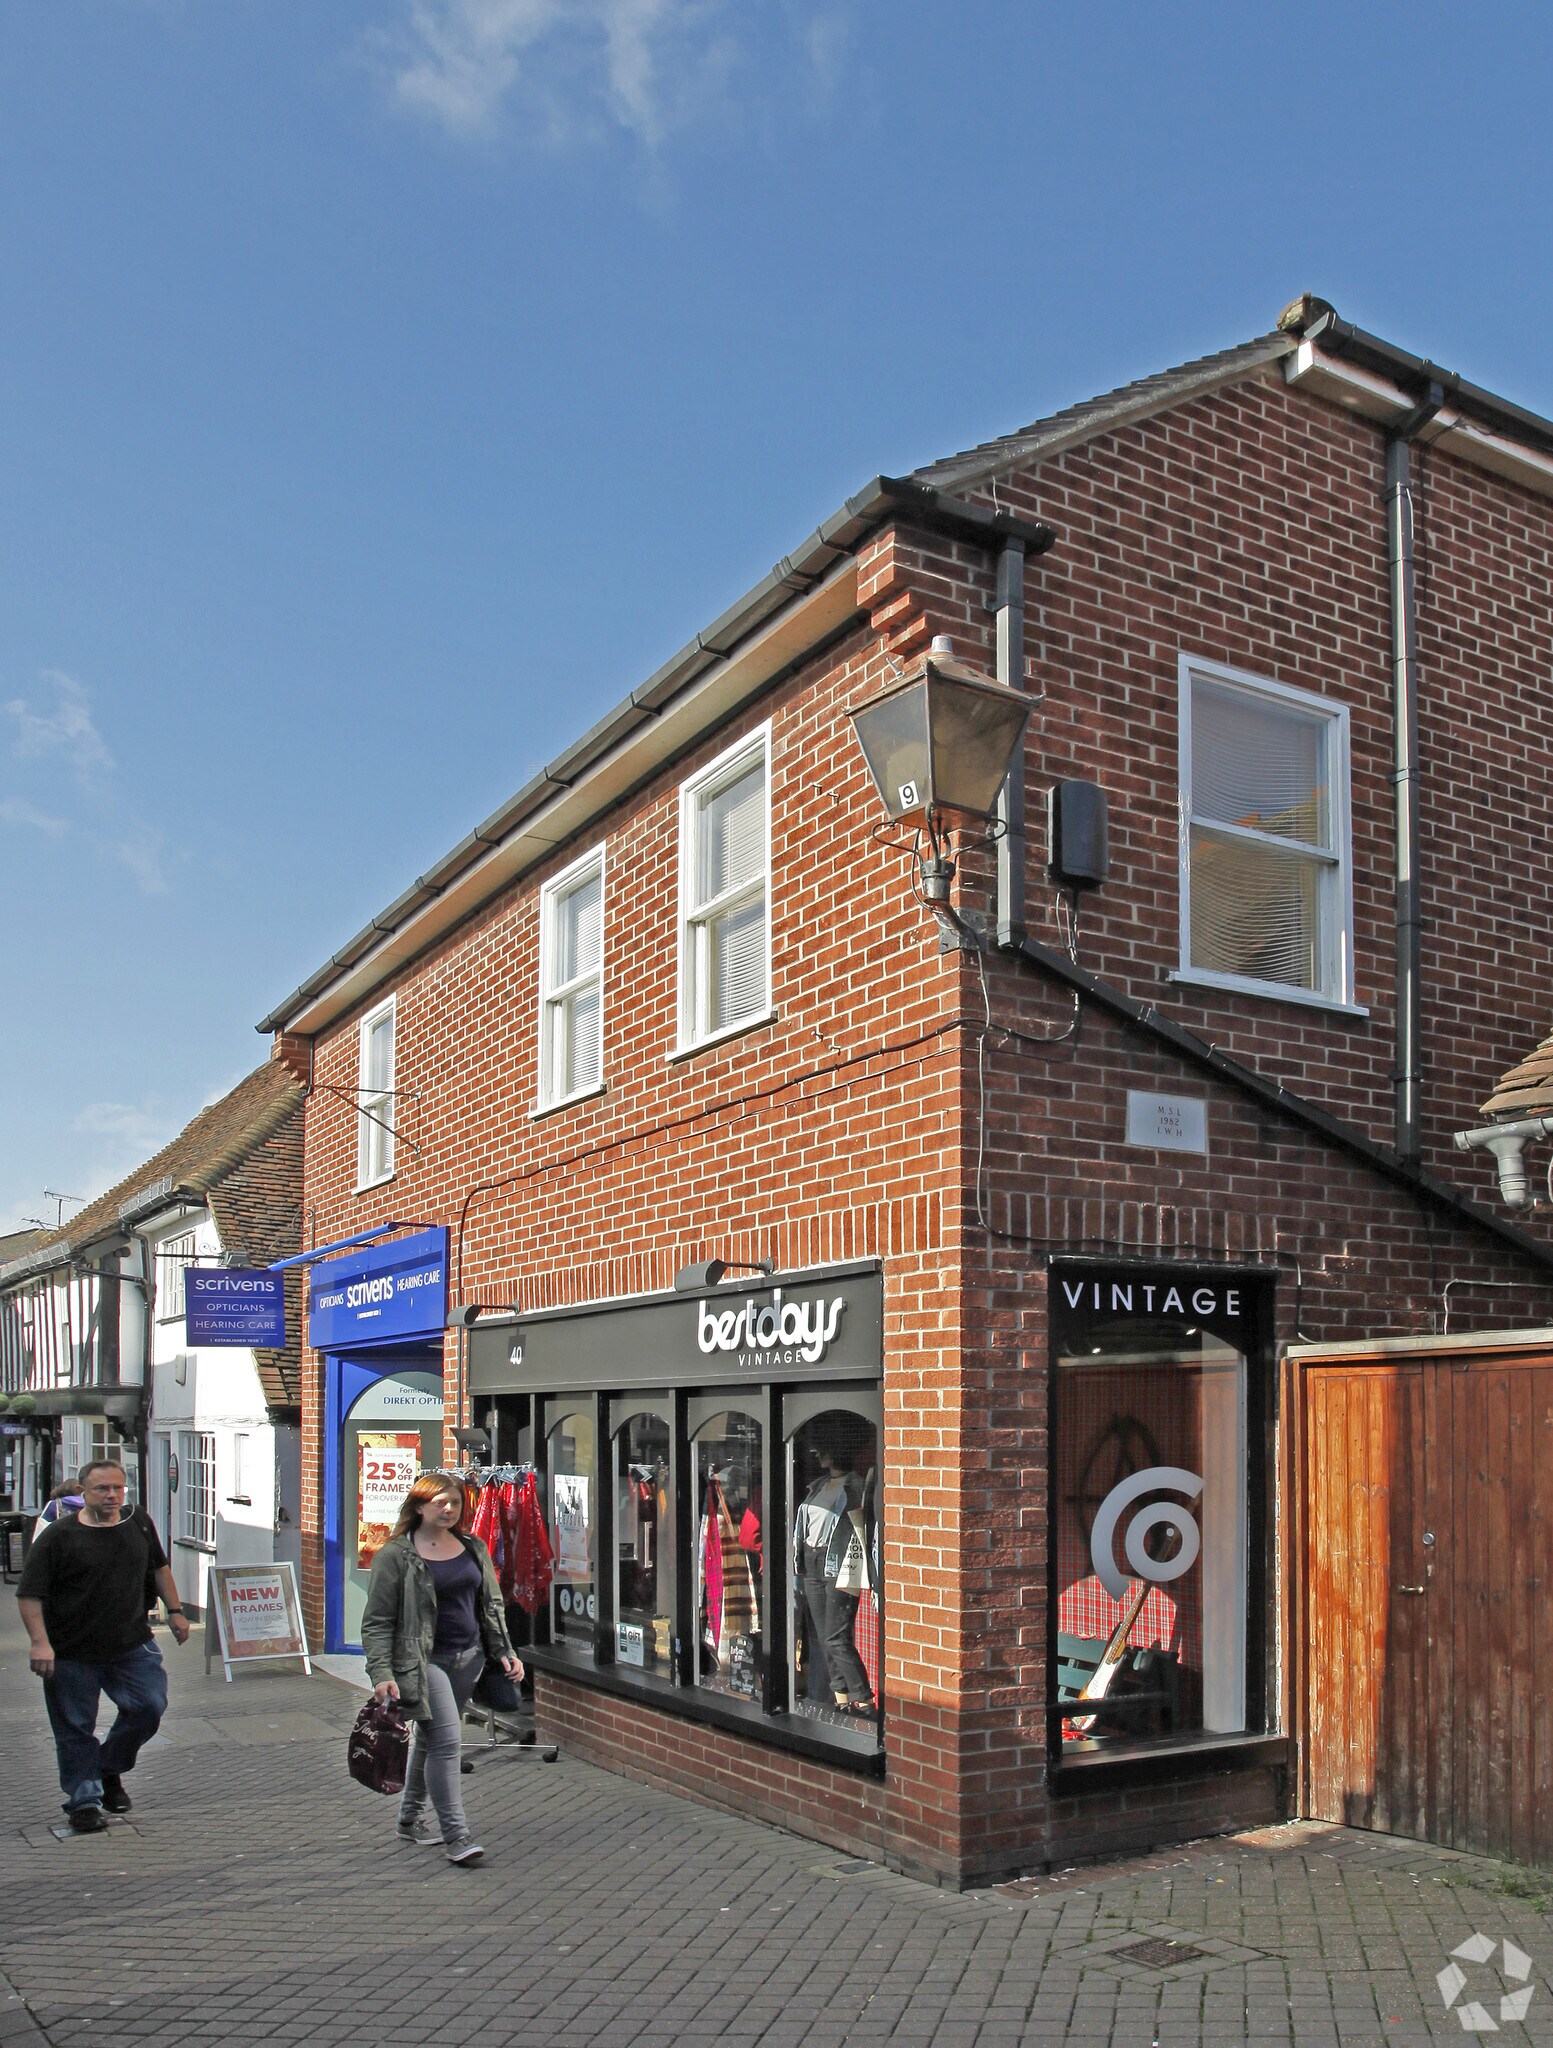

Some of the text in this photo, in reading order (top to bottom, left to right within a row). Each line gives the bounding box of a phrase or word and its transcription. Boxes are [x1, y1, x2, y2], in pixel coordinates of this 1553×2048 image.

[902, 785, 915, 805] 9
[1160, 1116, 1180, 1126] 1982
[1176, 1129, 1182, 1137] H
[195, 1276, 275, 1292] scrivens
[319, 1269, 441, 1309] OPTICIANS scrivens HEARING CARE
[1062, 1281, 1240, 1316] VINTAGE
[206, 1303, 265, 1312] OPTICIANS
[195, 1320, 276, 1330] HEARING CARE
[698, 1288, 843, 1363] bestdays
[509, 1345, 522, 1365] 40
[738, 1350, 802, 1367] VINTAGE
[399, 1387, 431, 1395] Formerly
[383, 1396, 415, 1405] DIREKT
[3, 1427, 29, 1435] OPEN
[366, 1462, 413, 1480] 25%
[365, 1483, 413, 1493] FRAMES
[230, 1586, 280, 1602] NEW
[233, 1602, 284, 1614] FRAMES
